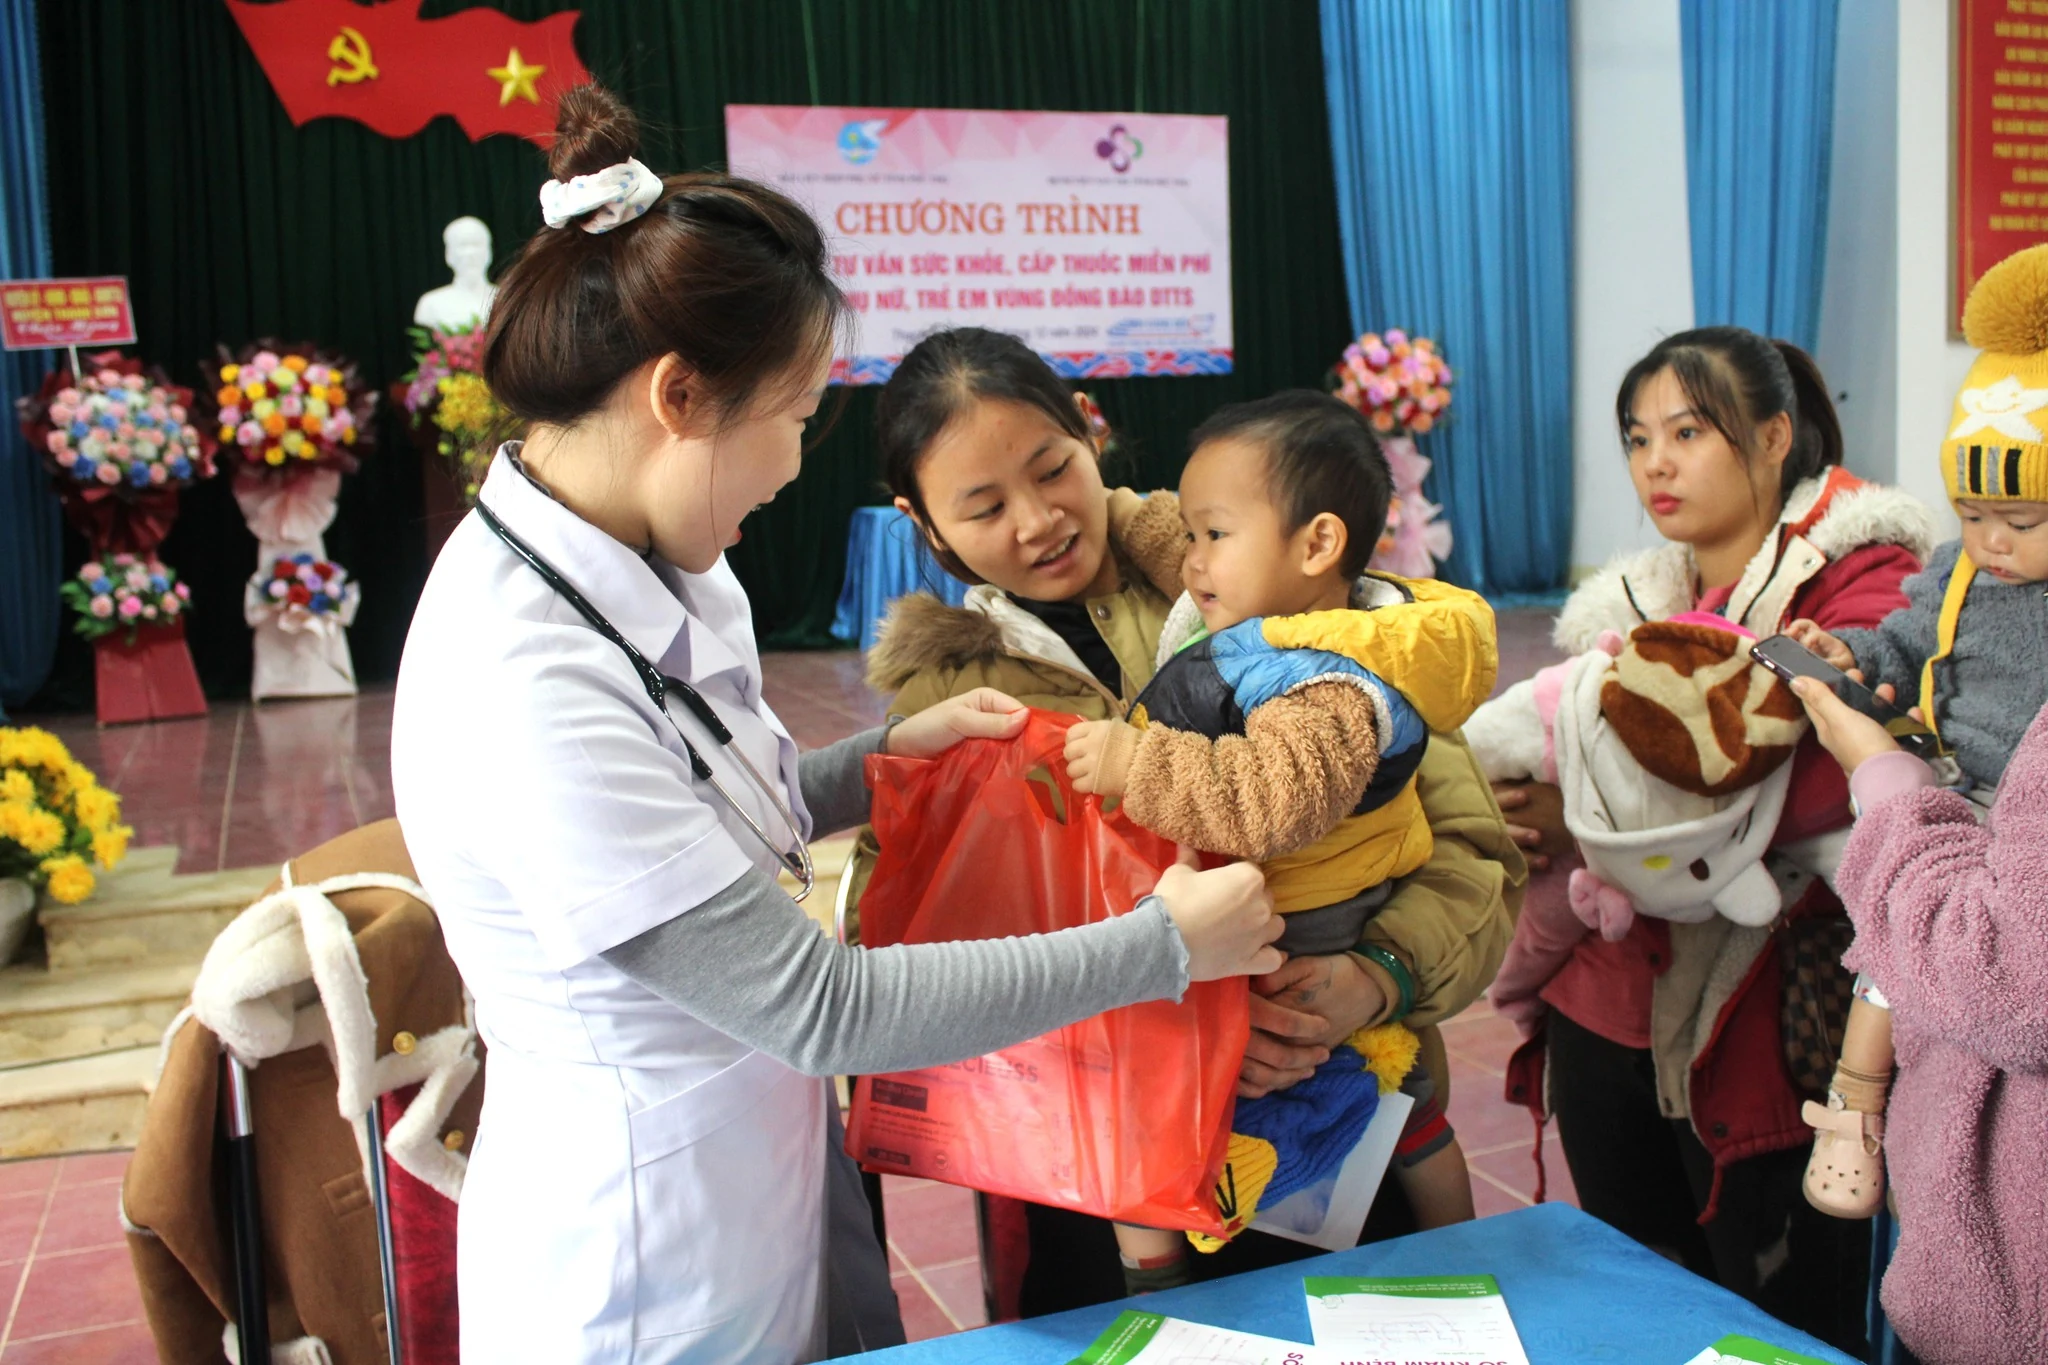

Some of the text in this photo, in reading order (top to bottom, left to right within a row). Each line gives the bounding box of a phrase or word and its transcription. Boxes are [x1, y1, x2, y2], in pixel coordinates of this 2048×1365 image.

[835, 194, 1142, 236] CHƯƠNG TRÌNH
[910, 250, 949, 276] SỨC
[1181, 249, 1211, 273] PHÍ
[958, 288, 988, 309] EM
